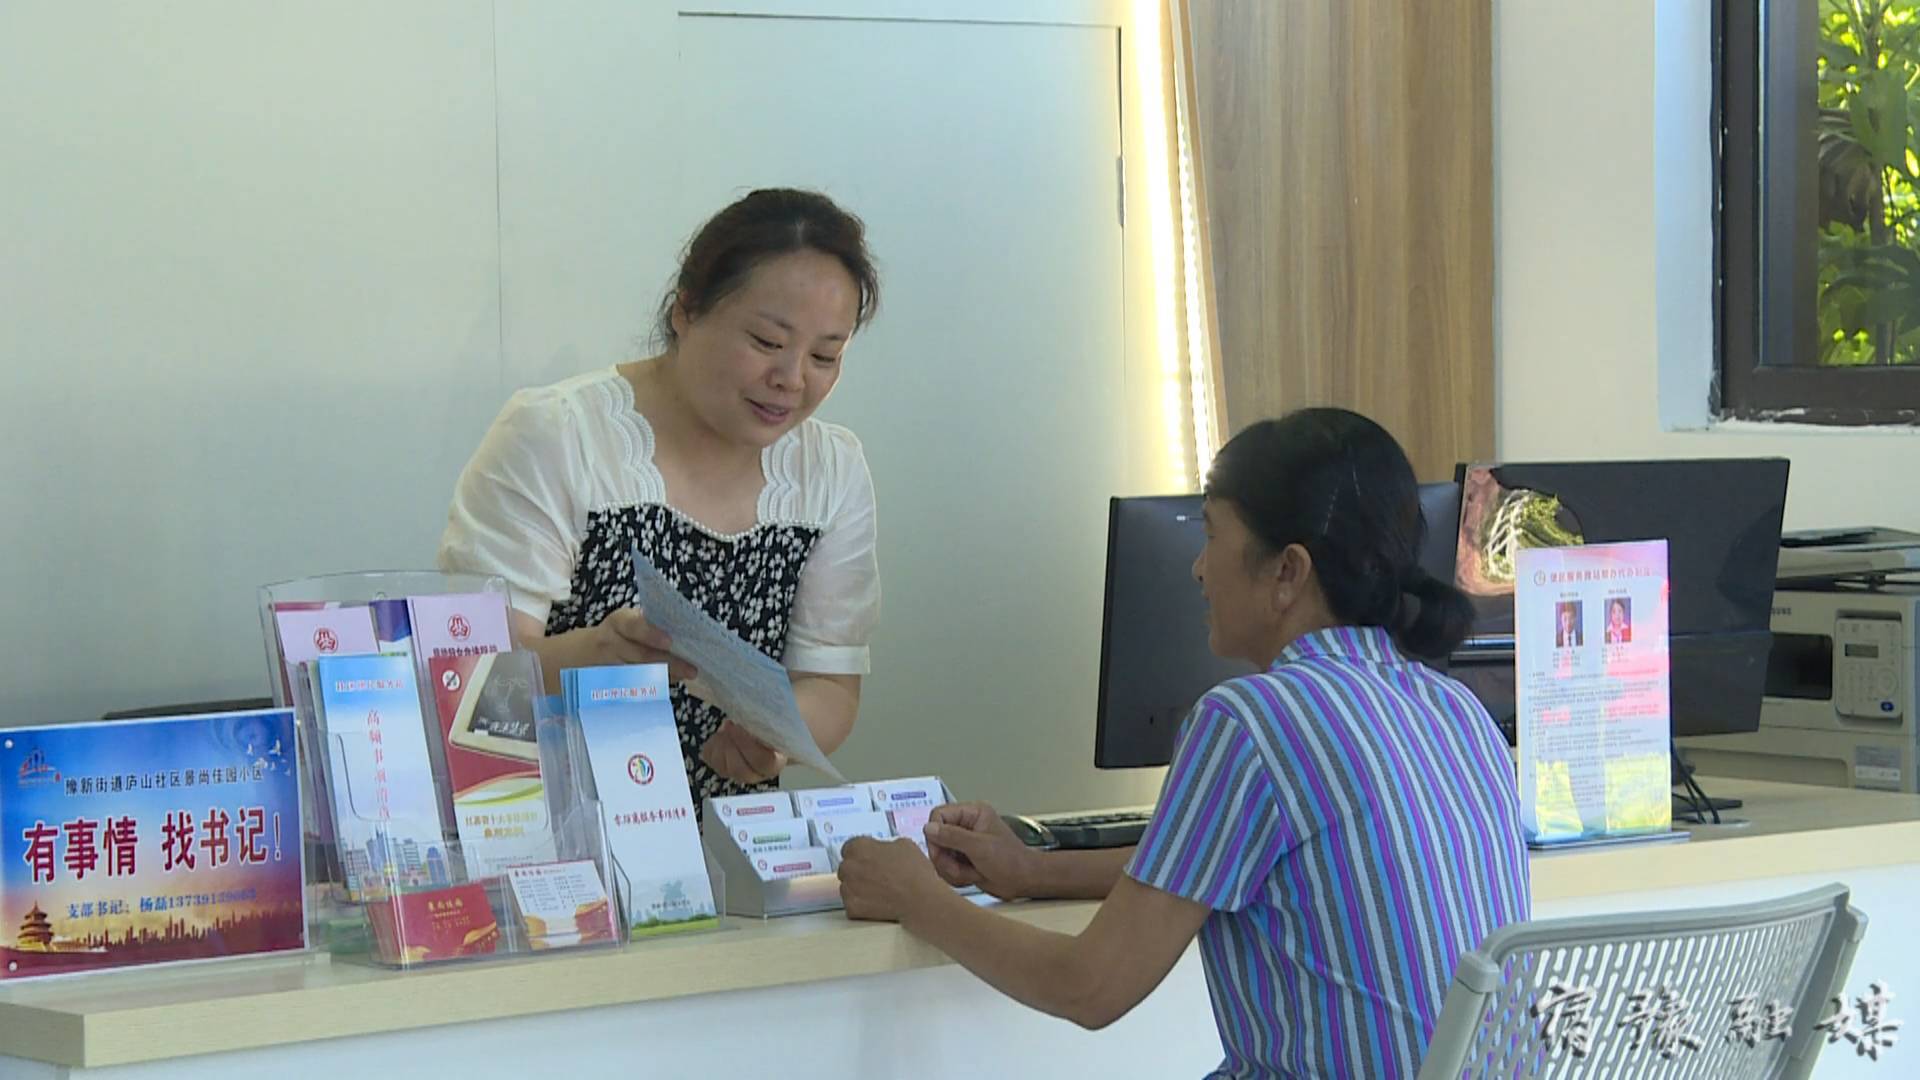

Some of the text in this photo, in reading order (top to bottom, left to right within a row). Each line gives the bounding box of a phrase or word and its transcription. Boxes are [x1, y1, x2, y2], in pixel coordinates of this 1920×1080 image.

[65, 765, 264, 795] 豫新街道庐山社区景尚佳园小区
[23, 815, 139, 885] 有事情
